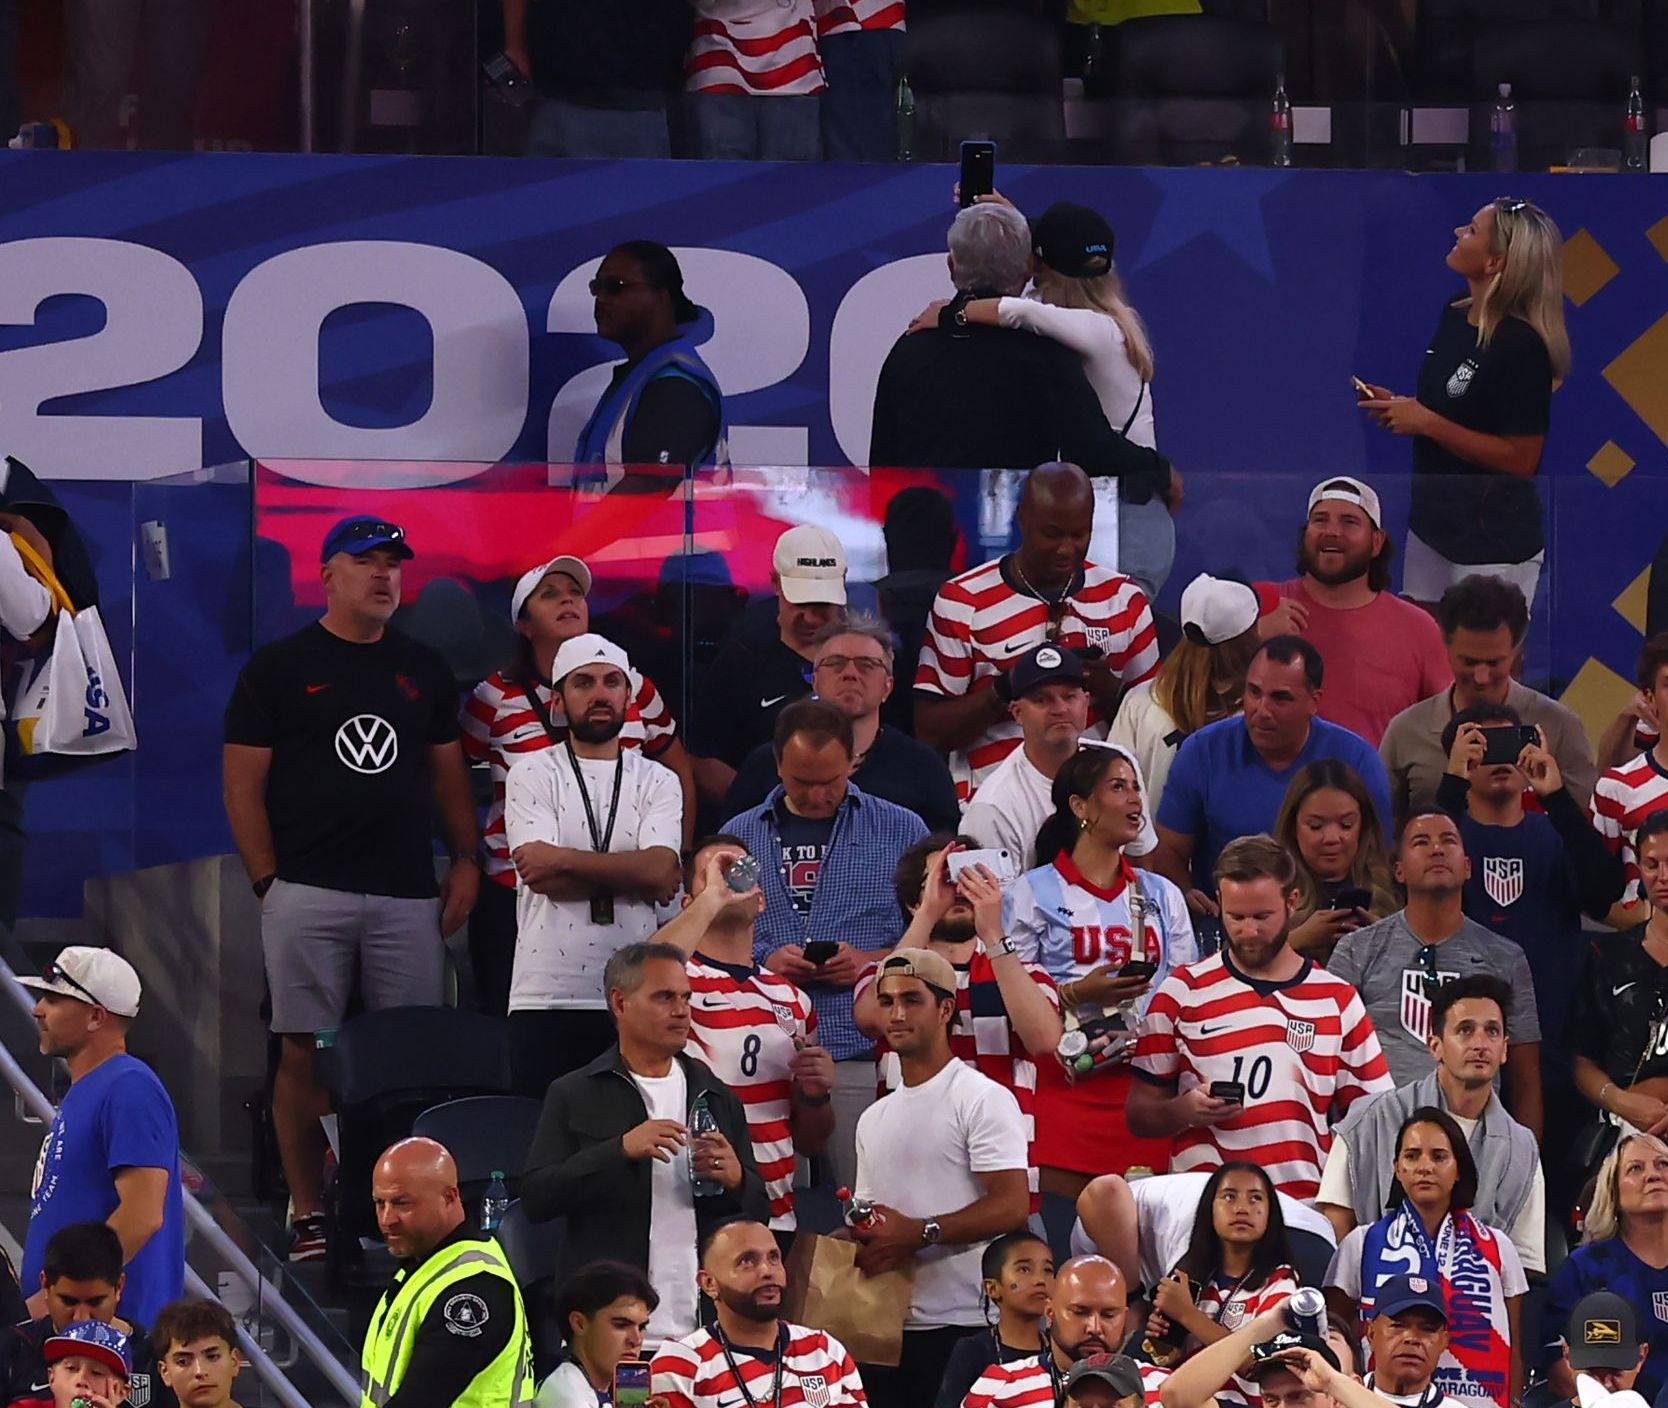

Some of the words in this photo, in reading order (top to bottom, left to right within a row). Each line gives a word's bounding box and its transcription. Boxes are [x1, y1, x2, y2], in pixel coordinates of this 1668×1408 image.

[797, 557, 837, 567] HIGHLANDS
[1487, 858, 1520, 879] USA
[1072, 925, 1161, 965] USA
[741, 1034, 762, 1077] 8
[1232, 1055, 1273, 1099] 10
